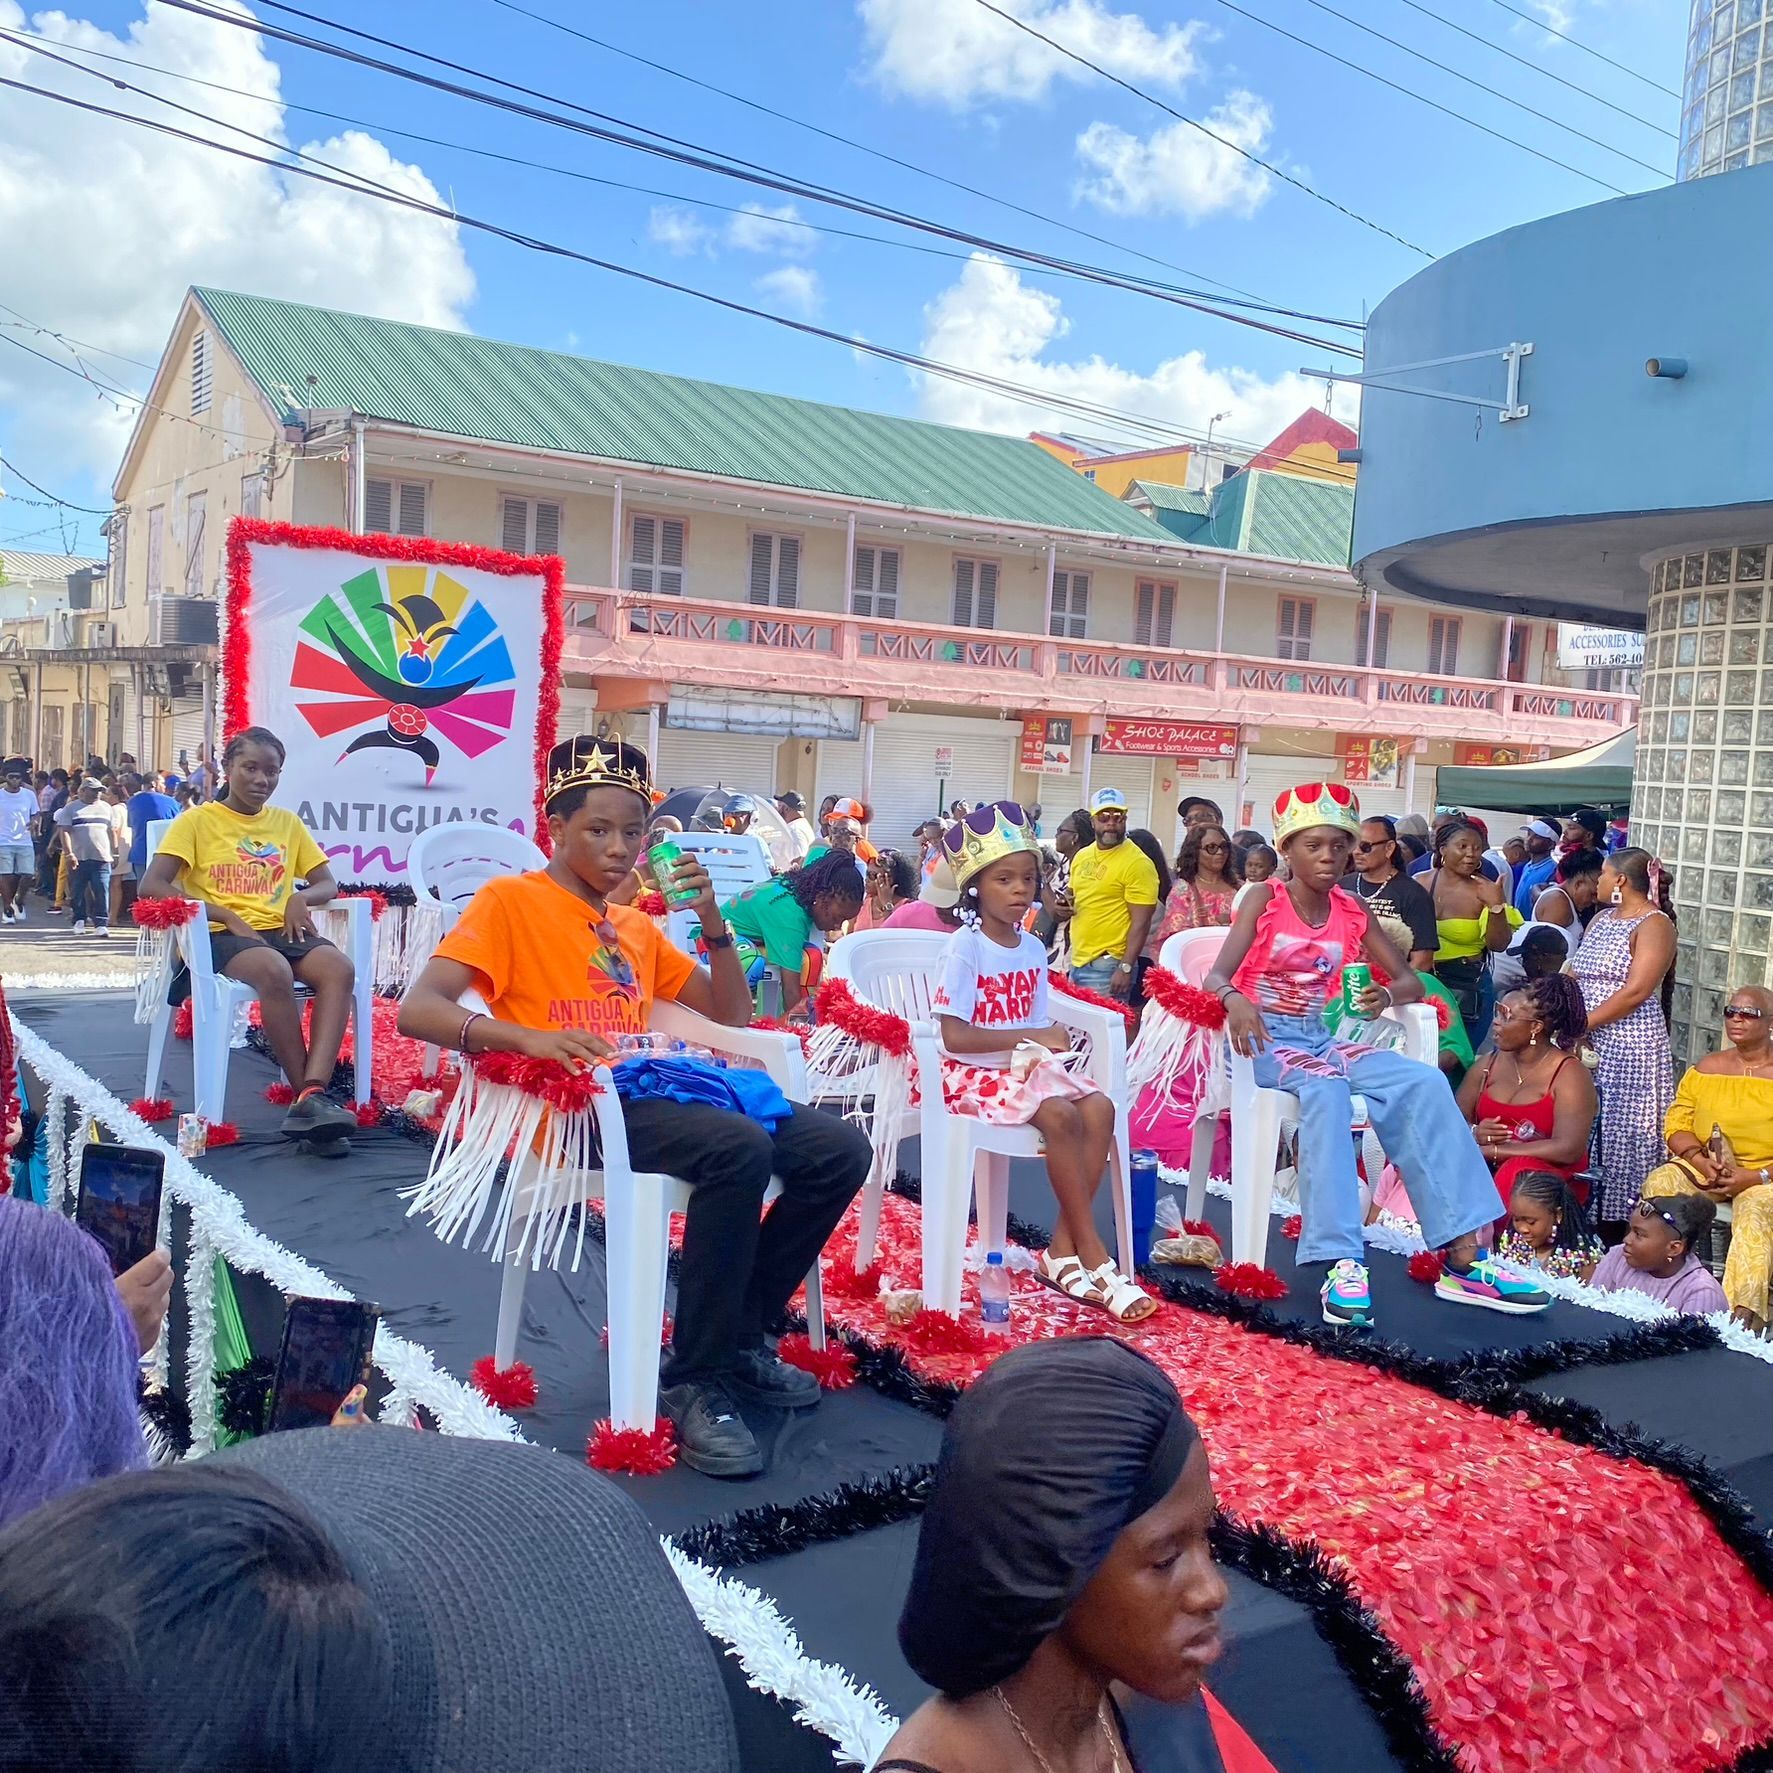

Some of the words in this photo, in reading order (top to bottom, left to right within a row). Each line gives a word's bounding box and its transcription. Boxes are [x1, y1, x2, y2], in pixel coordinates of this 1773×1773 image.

[1569, 634, 1627, 649] ACCESSORIES
[1631, 633, 1646, 647] SU
[1584, 654, 1607, 665] TEL:
[1121, 725, 1164, 739] SHOE
[1167, 728, 1217, 742] PALACE
[1125, 741, 1156, 751] Footwear
[1163, 743, 1181, 752] Sports
[1183, 744, 1217, 754] Accessories
[209, 864, 258, 878] ANTIGUA
[216, 876, 275, 895] CARNIVAL
[1347, 973, 1362, 1011] Sprite
[548, 999, 624, 1022] ANTIGUA
